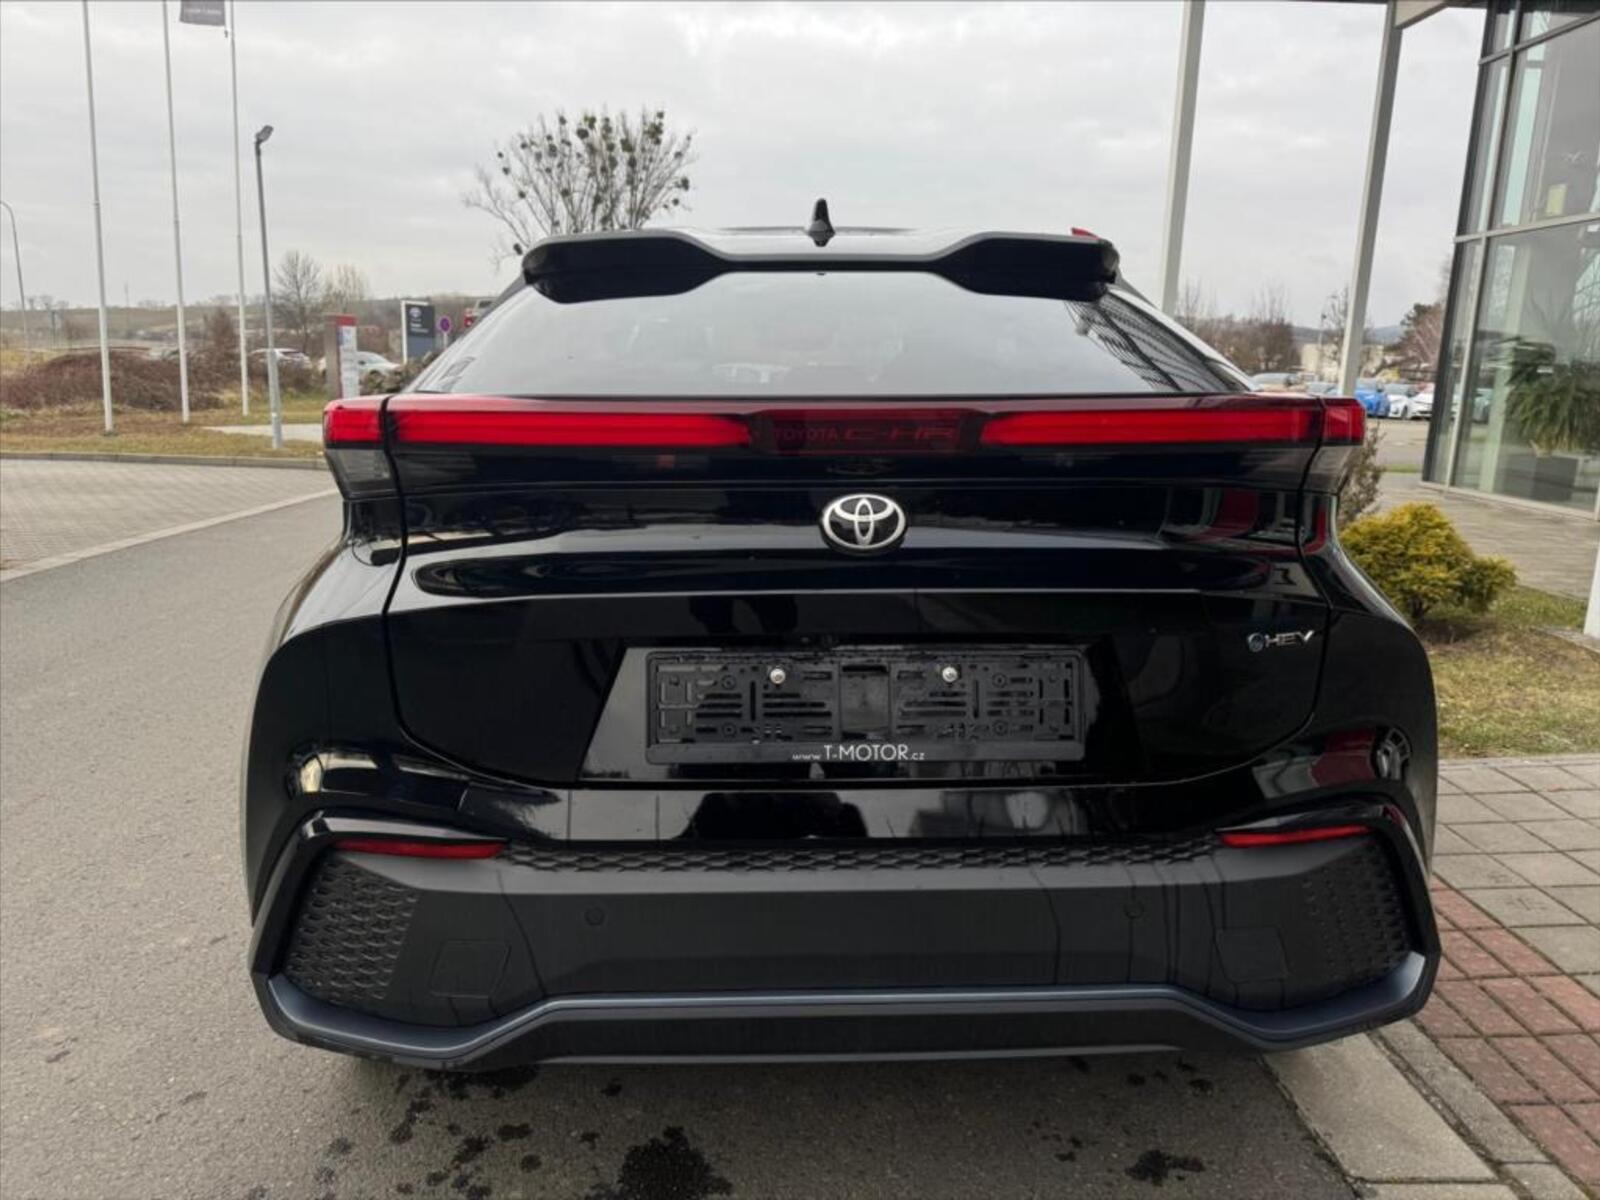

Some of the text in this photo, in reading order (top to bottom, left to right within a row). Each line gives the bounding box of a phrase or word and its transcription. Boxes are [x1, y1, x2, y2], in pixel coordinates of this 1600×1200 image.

[773, 427, 955, 441] TOYOTA C-HR
[1263, 630, 1315, 648] HEV
